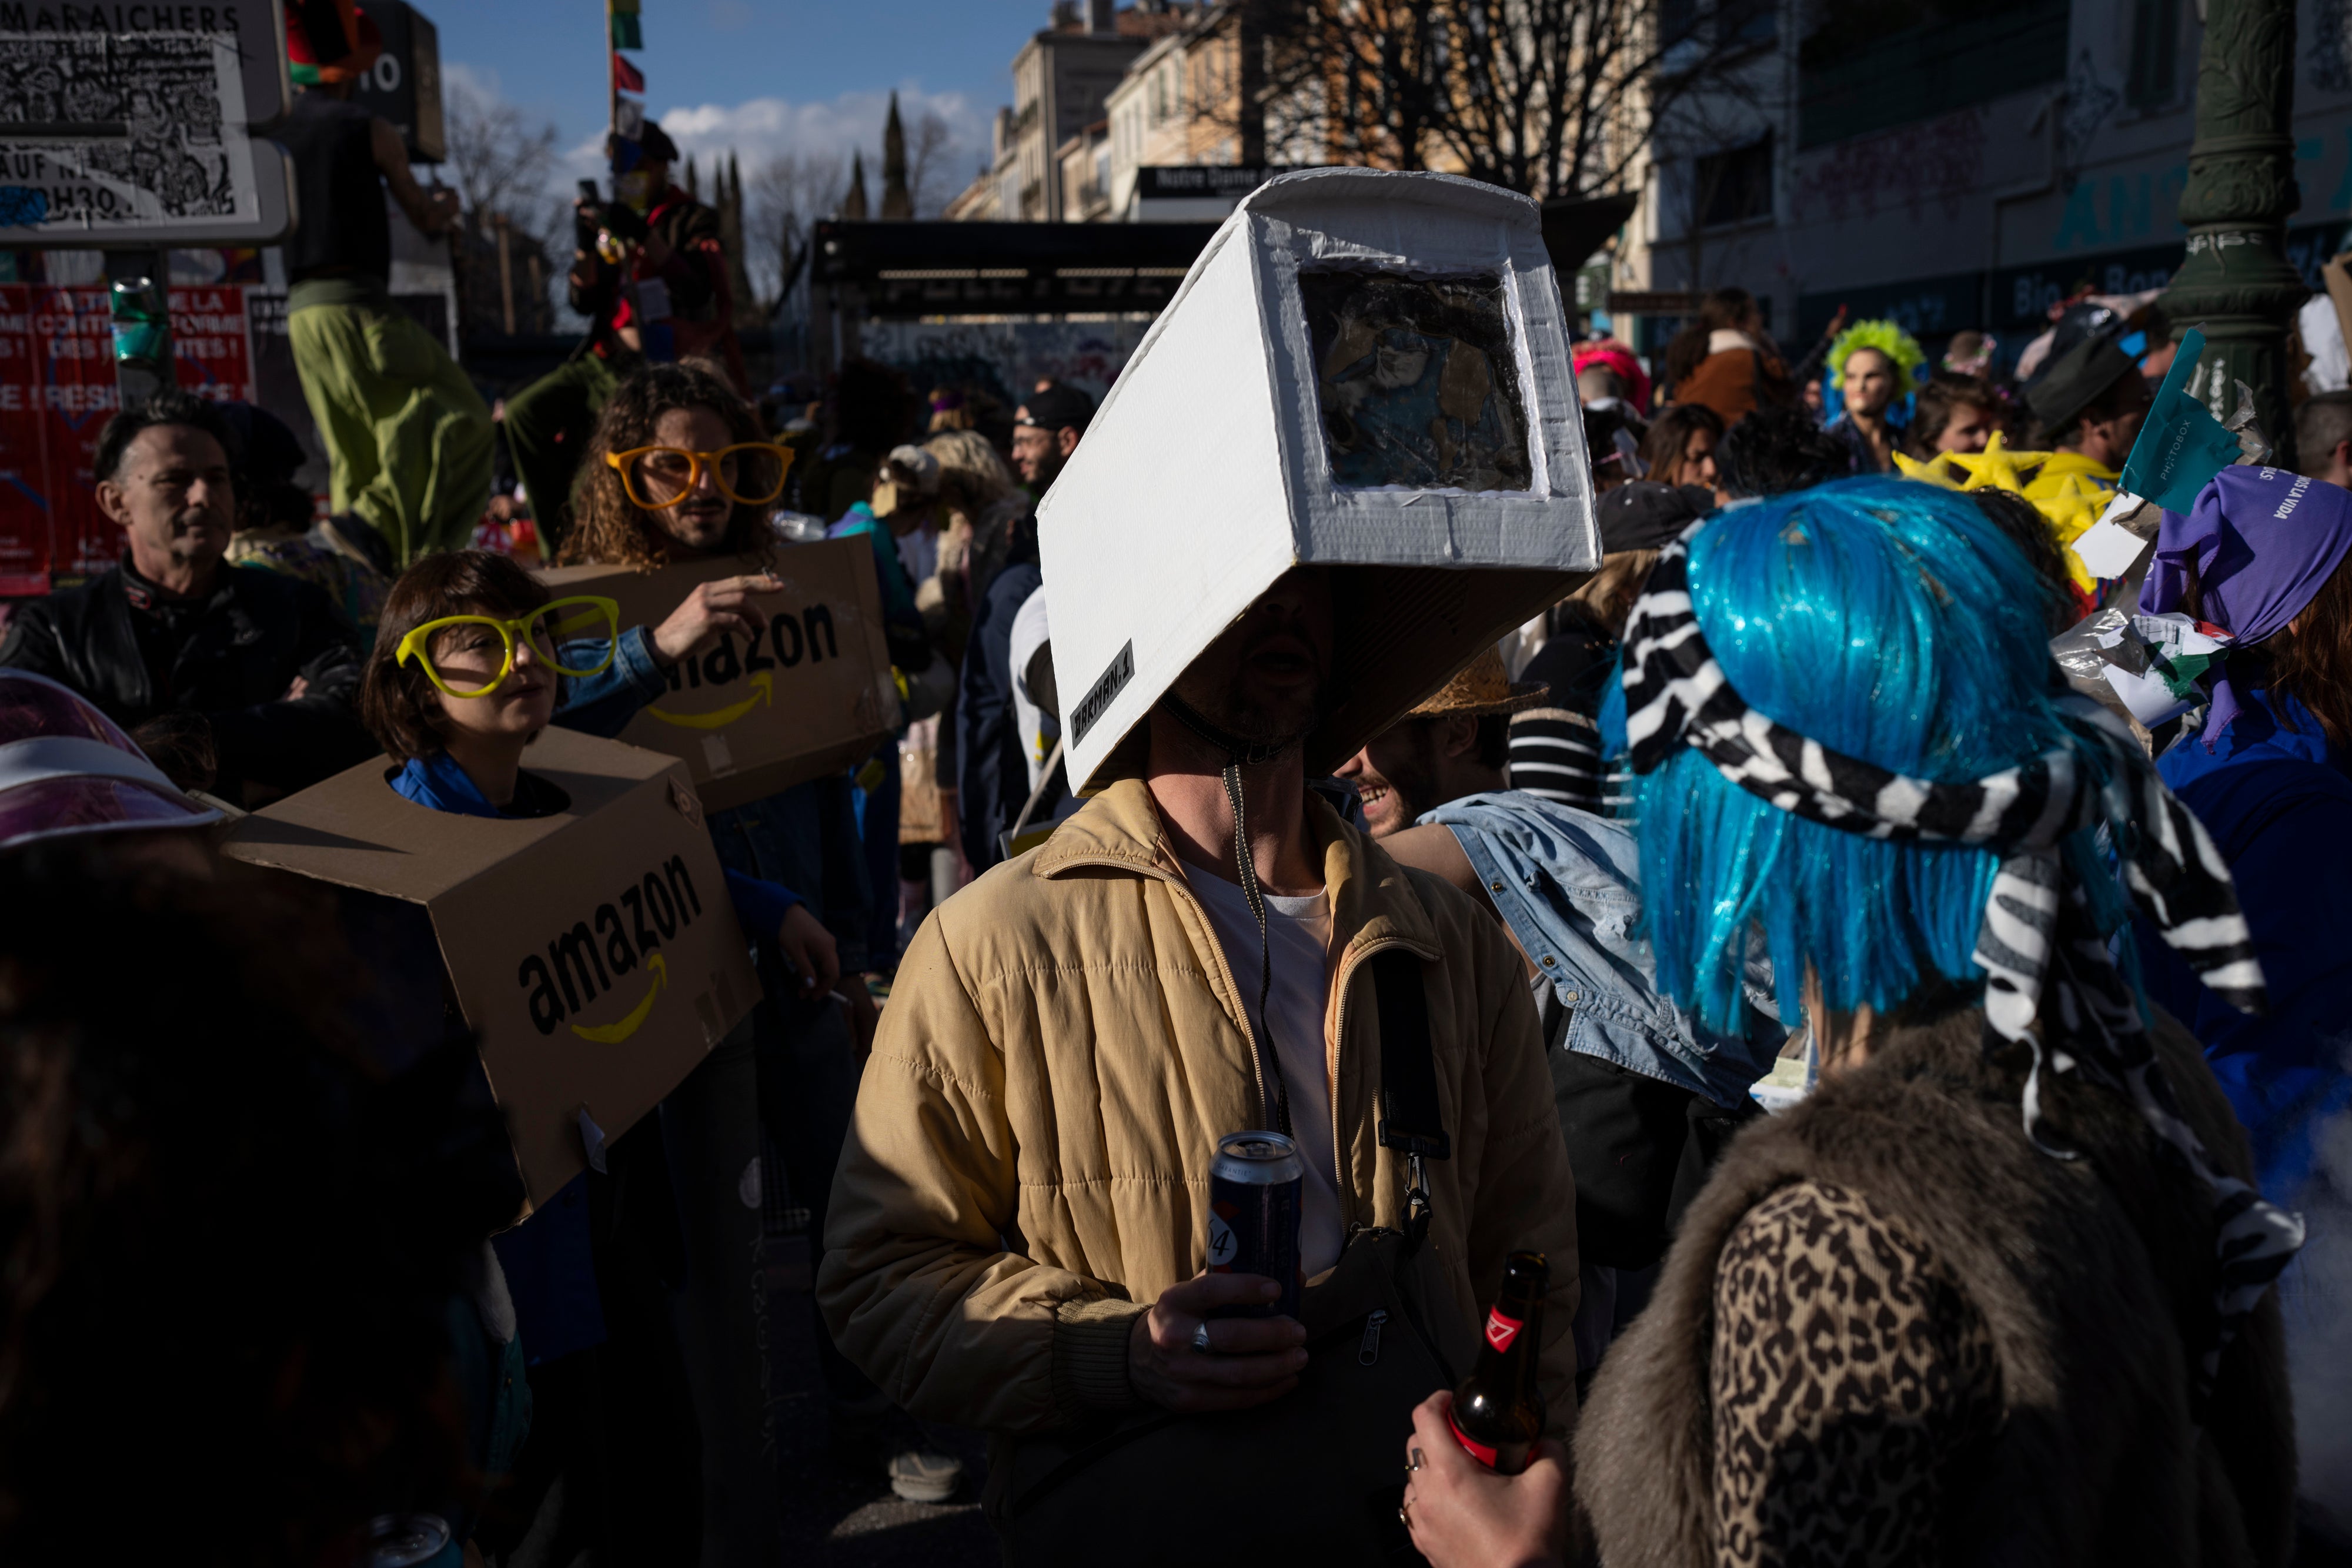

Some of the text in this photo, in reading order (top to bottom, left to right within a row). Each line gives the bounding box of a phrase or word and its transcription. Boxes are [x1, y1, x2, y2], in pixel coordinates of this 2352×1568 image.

[1, 4, 239, 32] MARAICHERS
[2013, 272, 2062, 319] Bio
[2273, 498, 2300, 520] VIDA
[2288, 487, 2306, 498] LA
[663, 603, 838, 693] azon
[519, 854, 701, 1035] amazon
